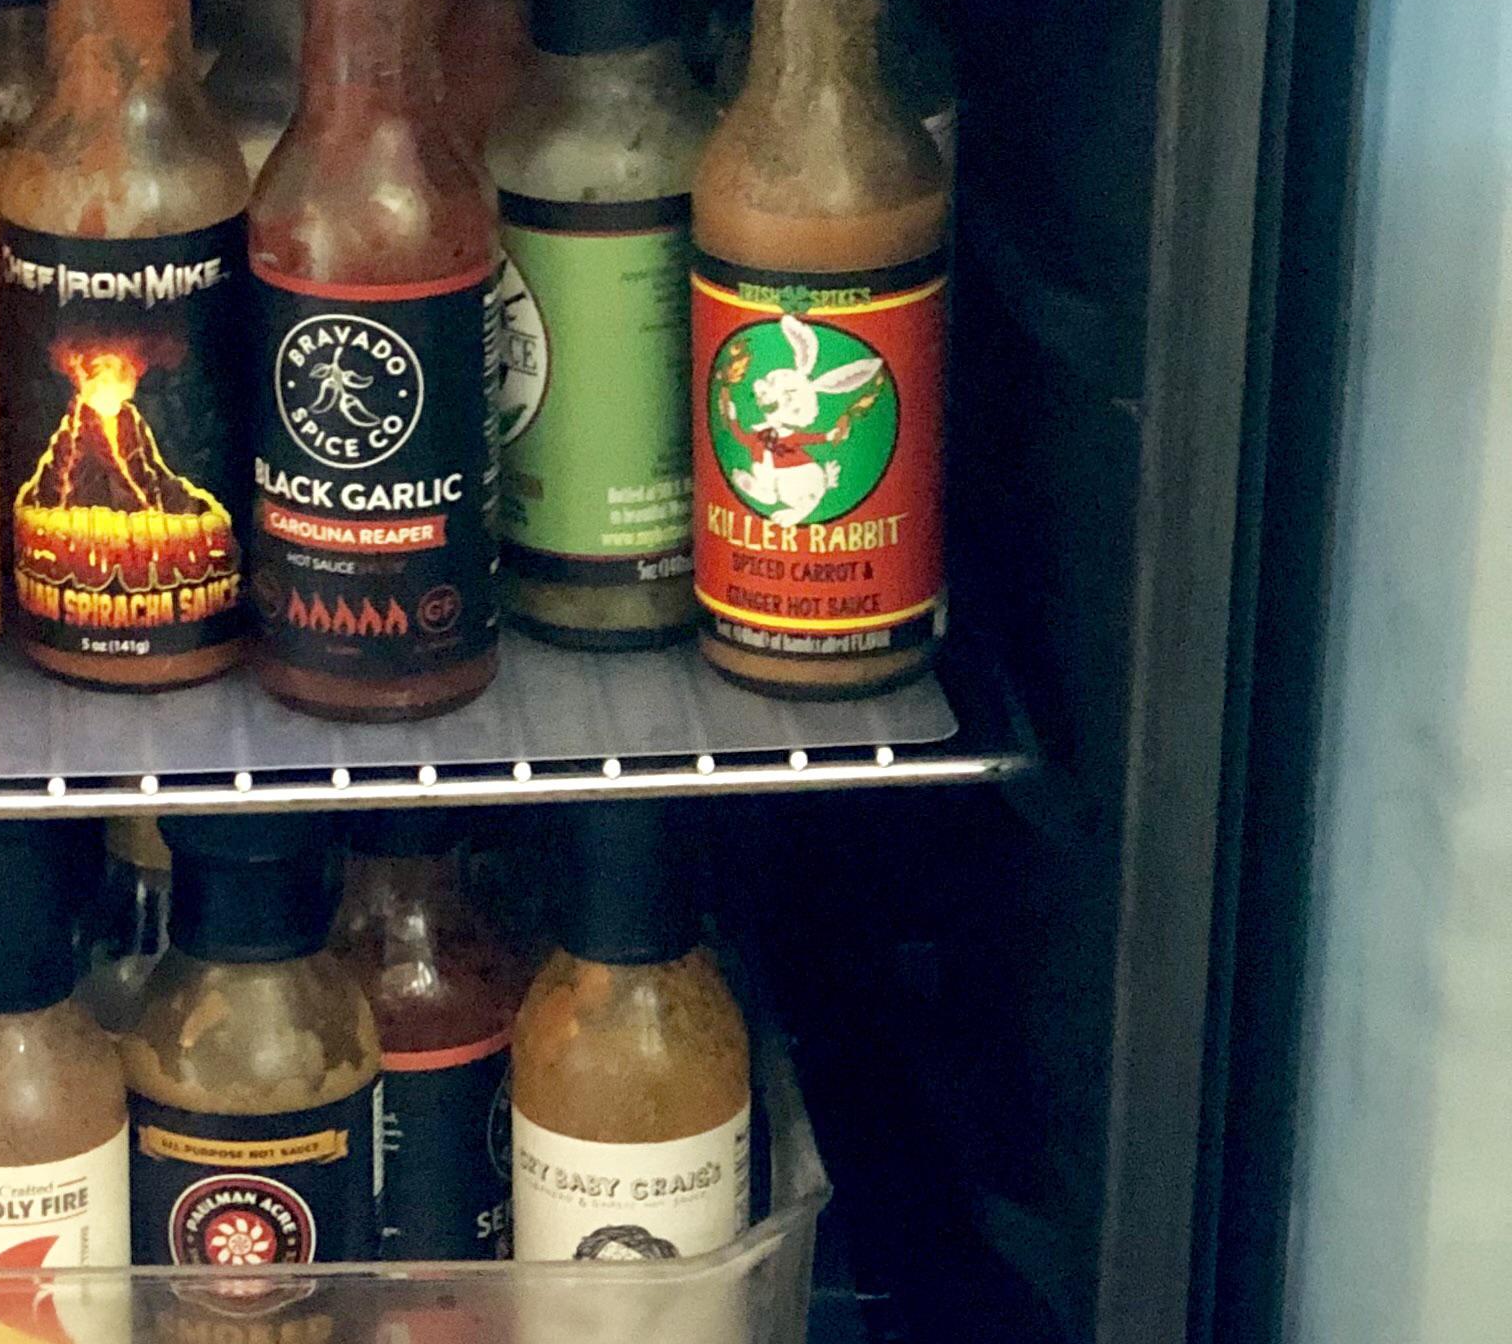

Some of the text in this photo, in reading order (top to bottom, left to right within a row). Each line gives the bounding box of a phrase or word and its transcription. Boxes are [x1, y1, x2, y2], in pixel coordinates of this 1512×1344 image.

[738, 283, 872, 307] IRISH SPIKE'S
[289, 325, 408, 377] BRAVADO
[292, 406, 404, 458] SPICE CO
[255, 456, 464, 513] BLACK GARLIC
[269, 511, 435, 546] CAROLINA REAPER
[707, 502, 799, 553] KILLER
[809, 511, 910, 554] RABBIT
[312, 555, 356, 575] SAUCE
[732, 552, 785, 581] SPICED
[790, 560, 859, 582] CARROT
[788, 595, 821, 616] HOT
[828, 592, 881, 615] SAUCE
[185, 1144, 245, 1159] PURPOSE
[555, 1167, 620, 1198] BABY
[41, 1186, 89, 1218] FIRE
[187, 1190, 298, 1234] PAULMAN ACRE
